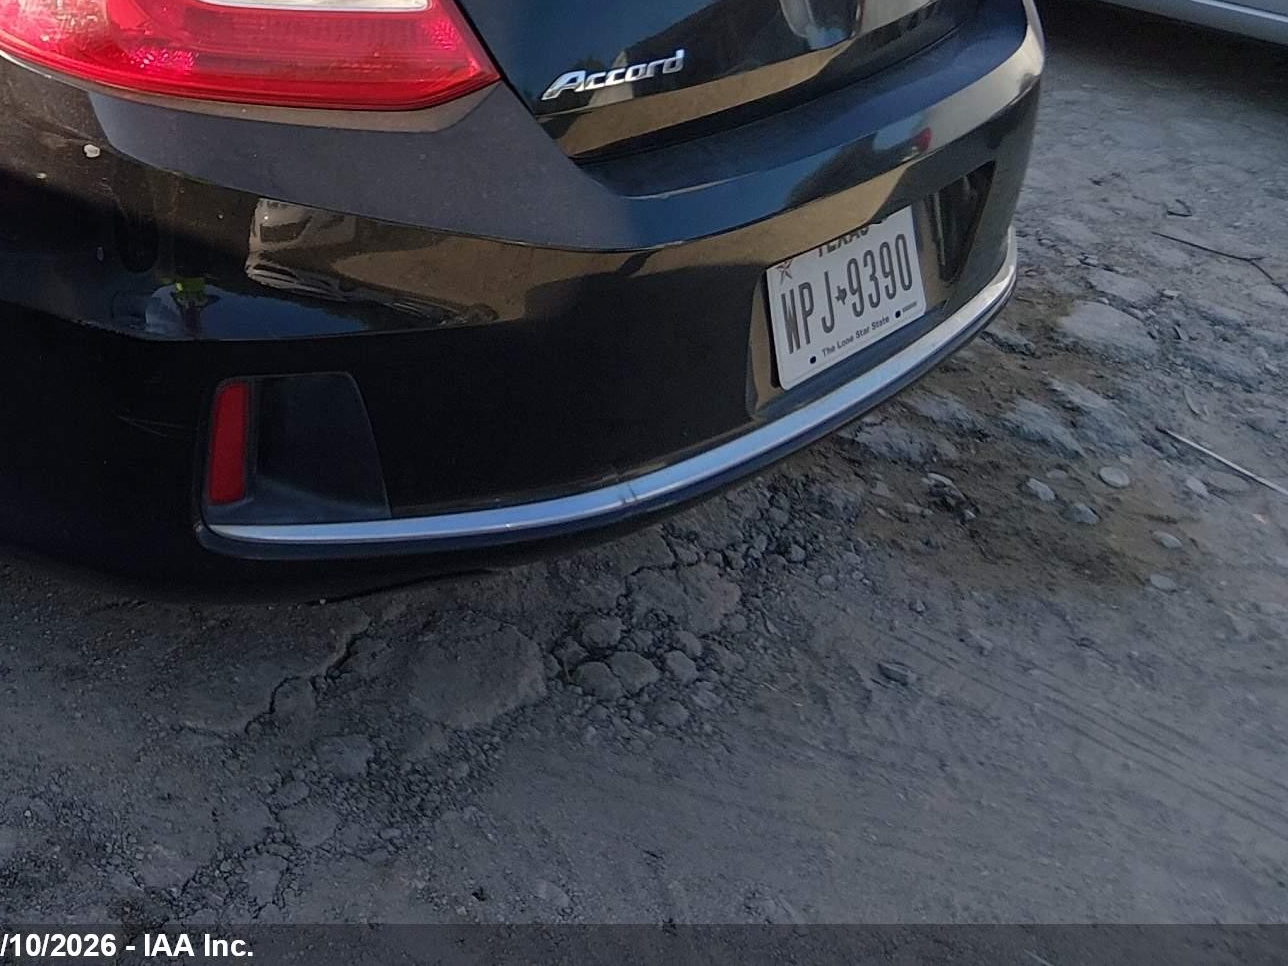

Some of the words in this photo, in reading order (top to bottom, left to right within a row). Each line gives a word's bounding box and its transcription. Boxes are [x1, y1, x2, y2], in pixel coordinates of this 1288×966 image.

[541, 49, 684, 100] Accord
[821, 345, 836, 357] The
[836, 336, 854, 350] Lone
[855, 326, 870, 339] Star
[872, 316, 890, 331] State
